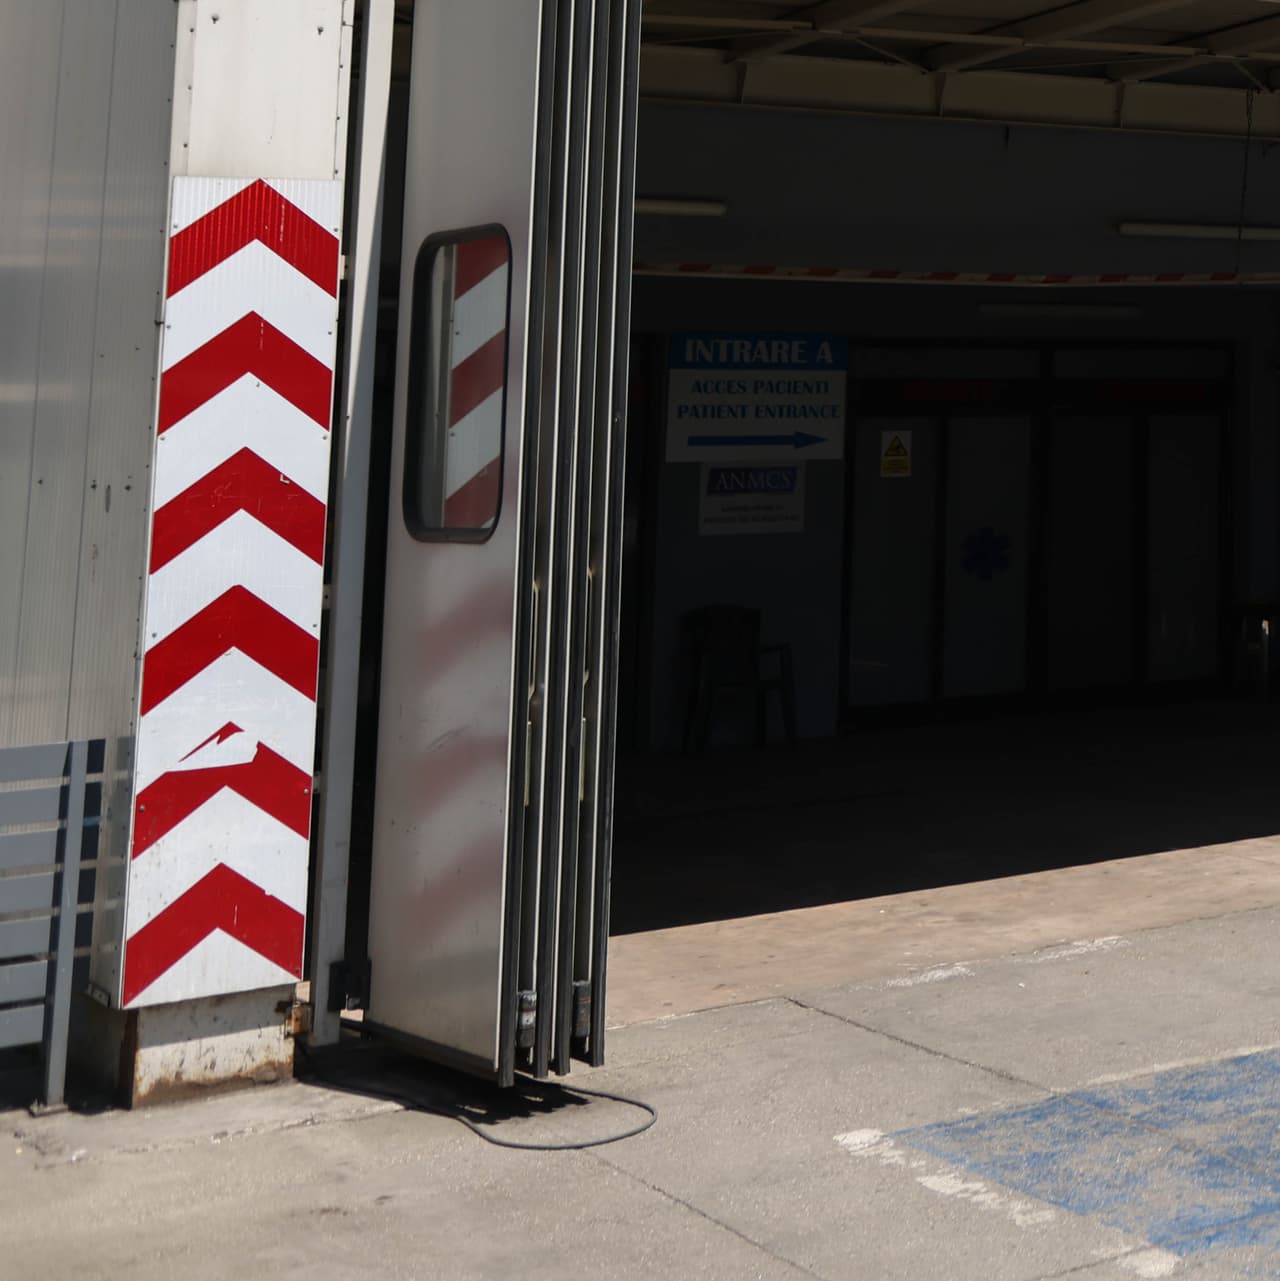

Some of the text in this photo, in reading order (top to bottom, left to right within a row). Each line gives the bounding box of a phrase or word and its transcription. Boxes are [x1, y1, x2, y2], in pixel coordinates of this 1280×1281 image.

[684, 336, 834, 365] INTRARE A
[690, 379, 748, 395] ACCES
[676, 404, 840, 419] PATIENT ENTRANCE
